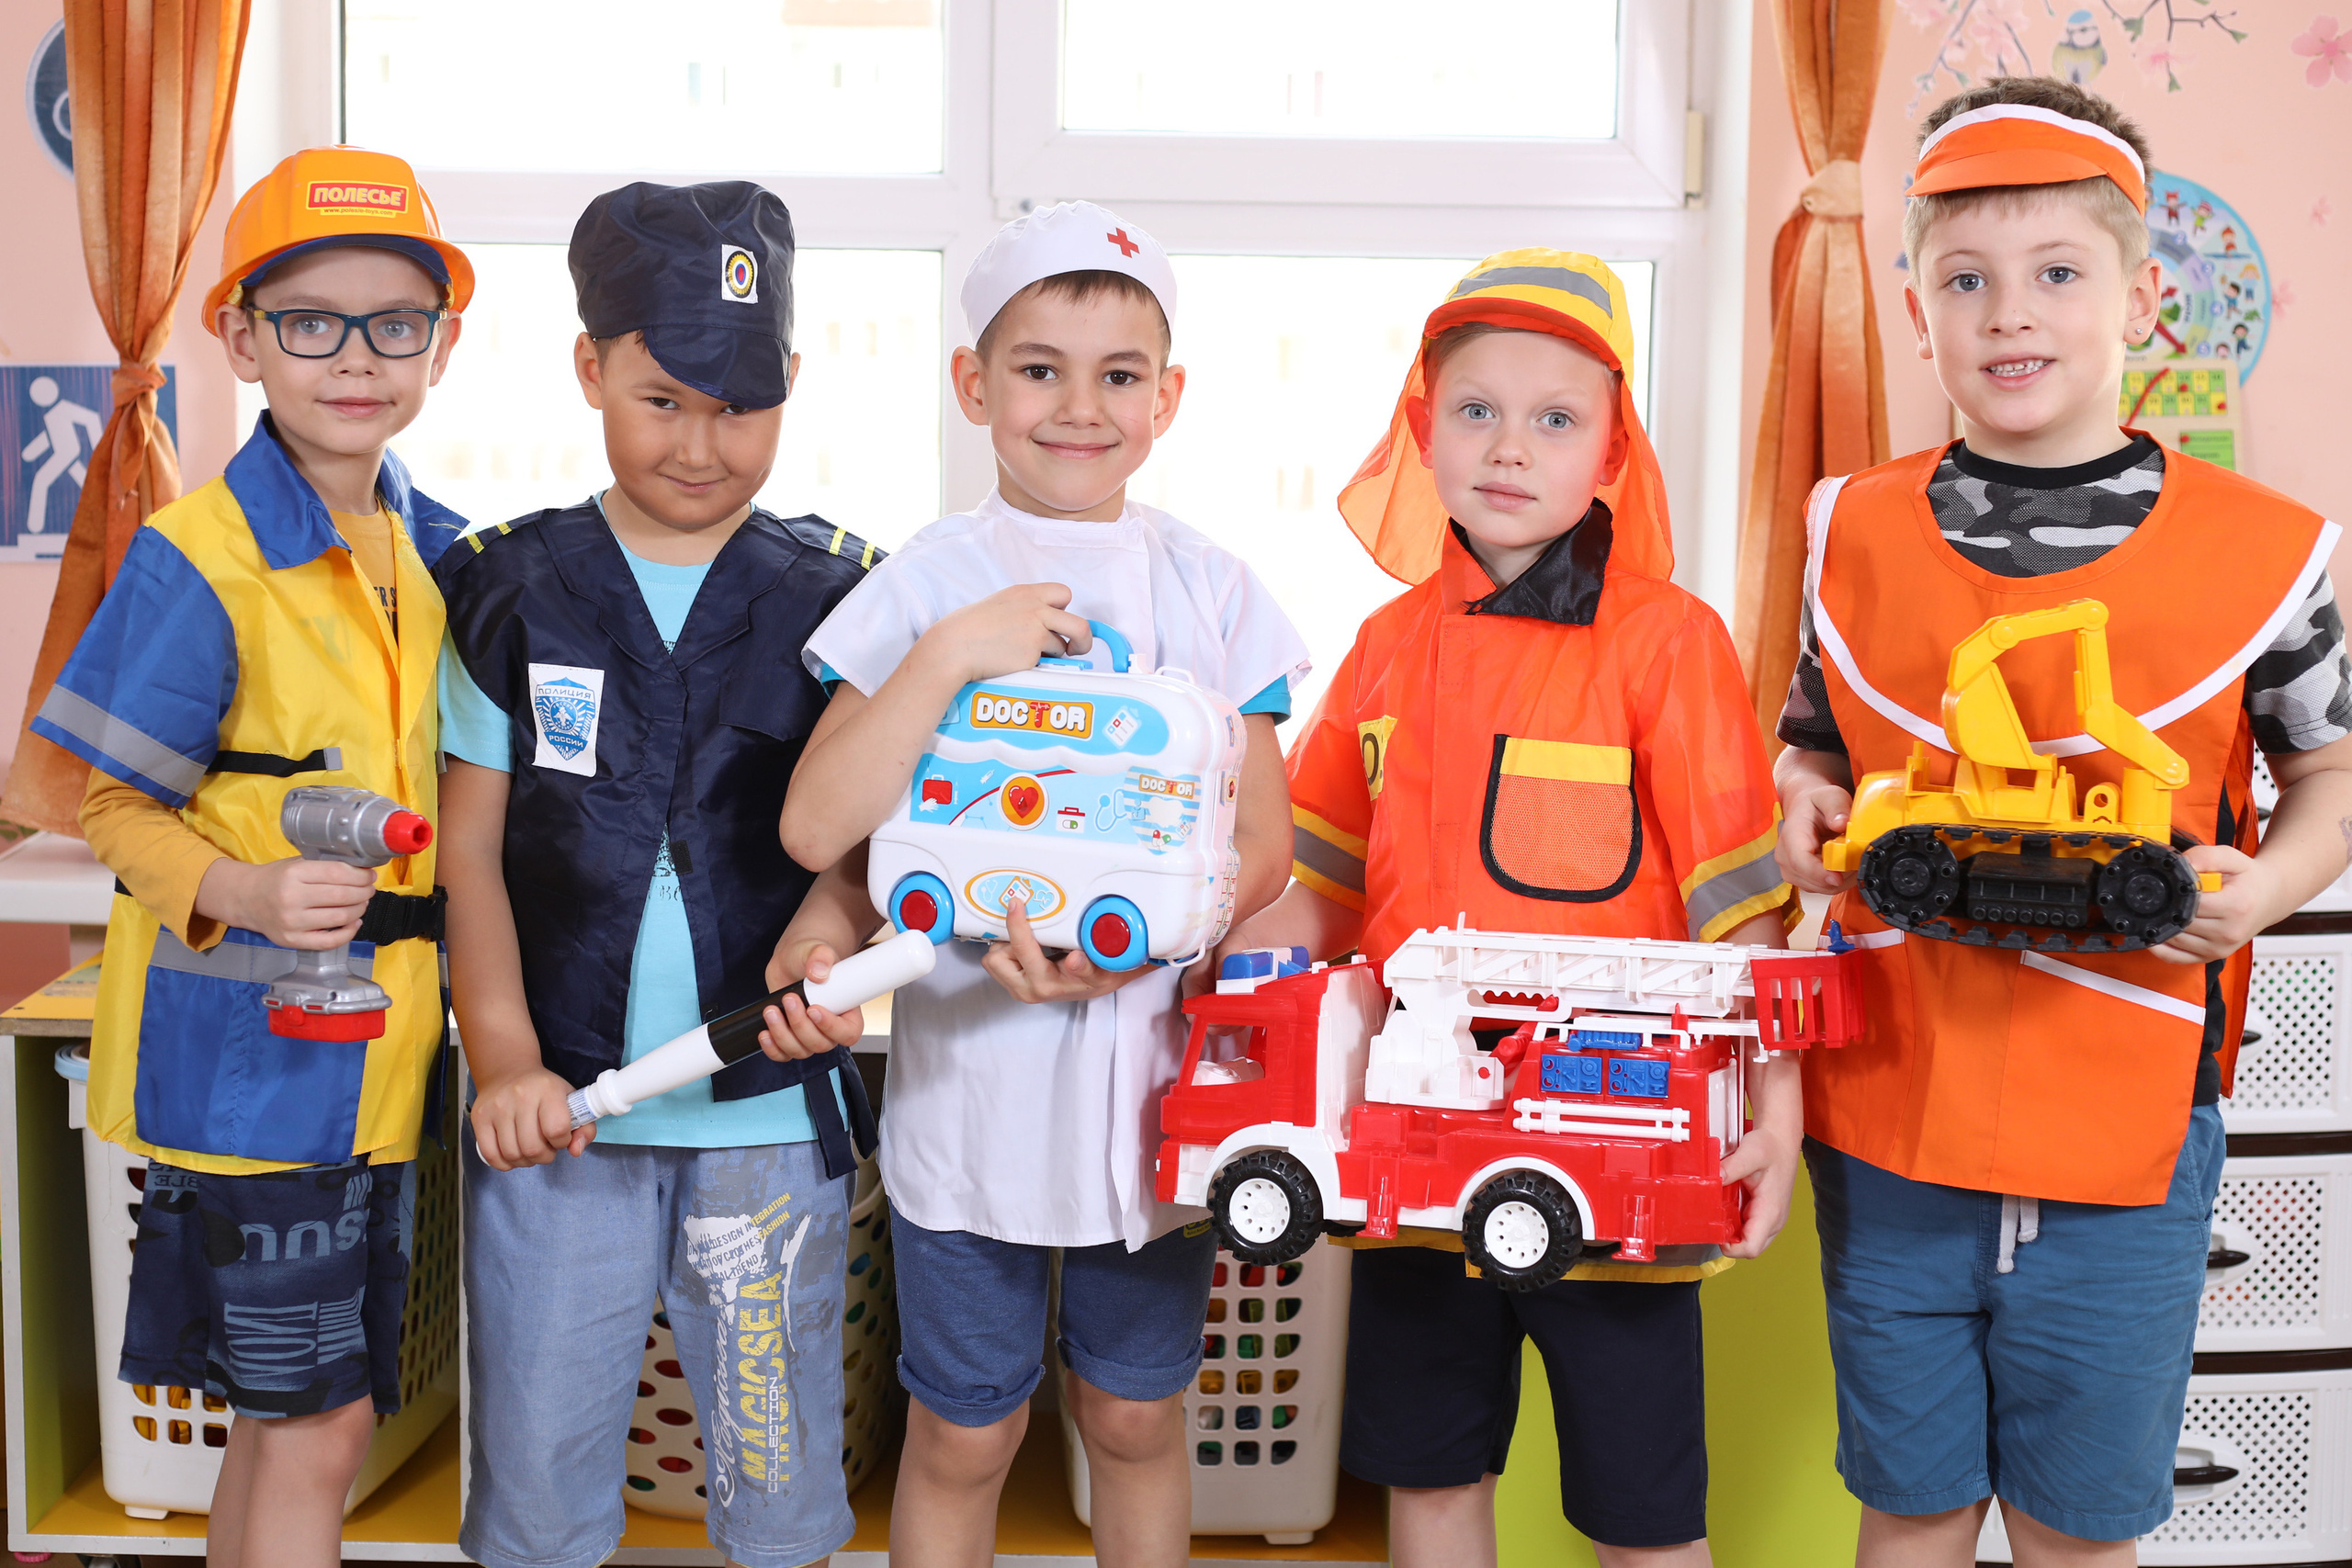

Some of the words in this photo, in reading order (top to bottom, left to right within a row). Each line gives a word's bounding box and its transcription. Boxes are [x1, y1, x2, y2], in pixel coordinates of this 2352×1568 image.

[313, 187, 401, 207] ПОЛЕСЬЕ
[537, 688, 591, 699] ПОЛИЦИЯ
[976, 696, 1086, 732] DOCTOR
[548, 735, 583, 748] РОССИИ
[1141, 777, 1193, 796] DOCTOR
[758, 1210, 791, 1241] FASHION
[767, 1377, 780, 1494] COLLECTION
